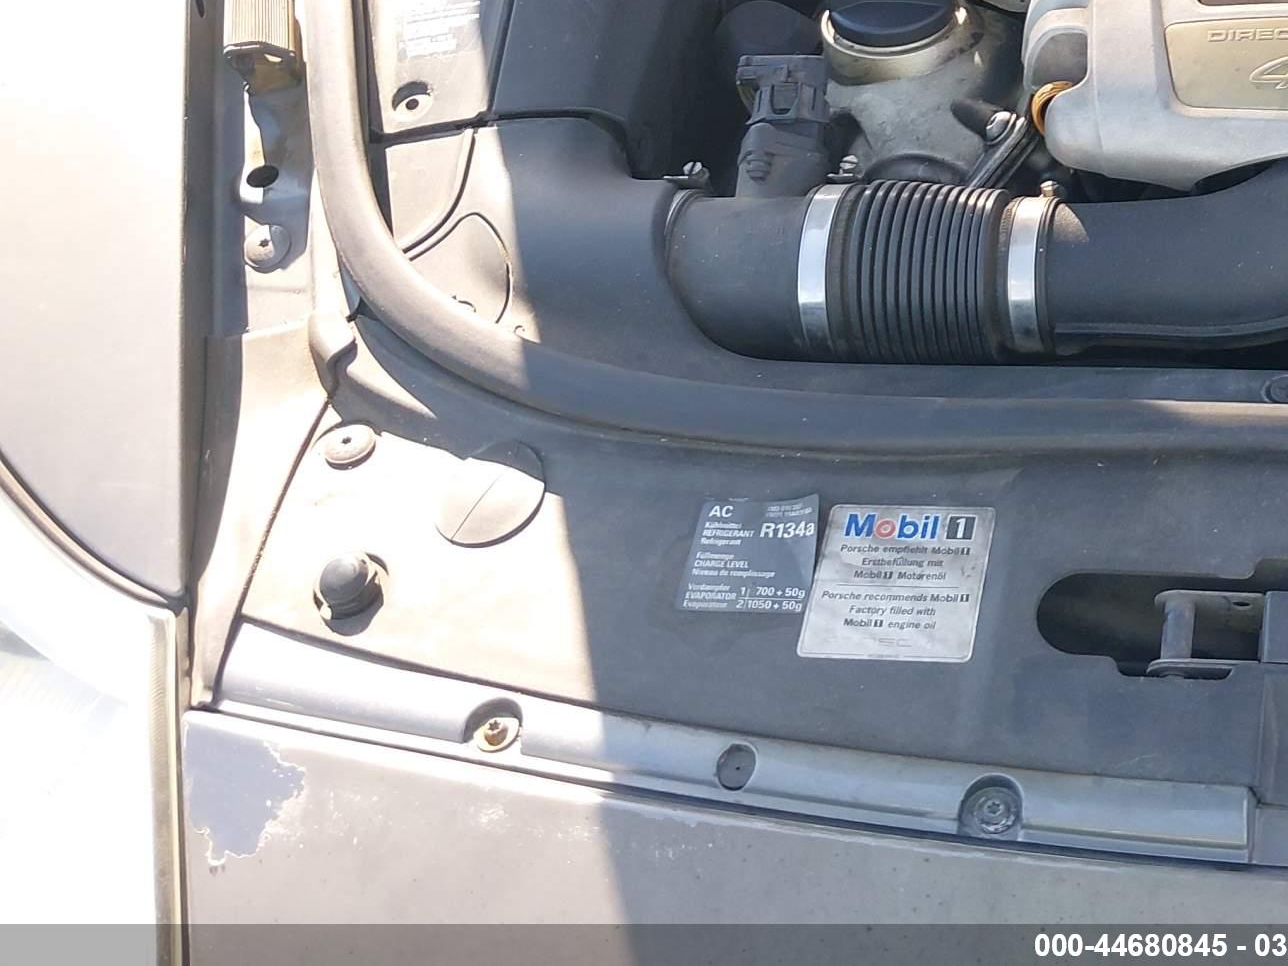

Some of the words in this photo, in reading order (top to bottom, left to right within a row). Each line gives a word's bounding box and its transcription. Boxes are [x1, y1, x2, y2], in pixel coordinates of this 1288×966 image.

[708, 505, 734, 518] AC
[702, 529, 755, 538] REFRIGERANT
[759, 521, 816, 539] R134a
[844, 512, 940, 540] Mobil
[840, 544, 879, 554] Porsche
[726, 560, 749, 569] LEVEL
[897, 570, 946, 581] Motorenöl
[755, 586, 774, 596] 700
[785, 587, 806, 599] 50g
[821, 590, 862, 601] Porsche
[863, 592, 928, 603] recommends
[747, 600, 771, 610] 1050
[781, 600, 803, 612] 50g
[848, 605, 887, 617] Factory
[889, 605, 914, 616] filled
[916, 607, 937, 617] with
[842, 618, 872, 628] Mobil
[887, 620, 922, 631] engine
[923, 620, 937, 630] oil
